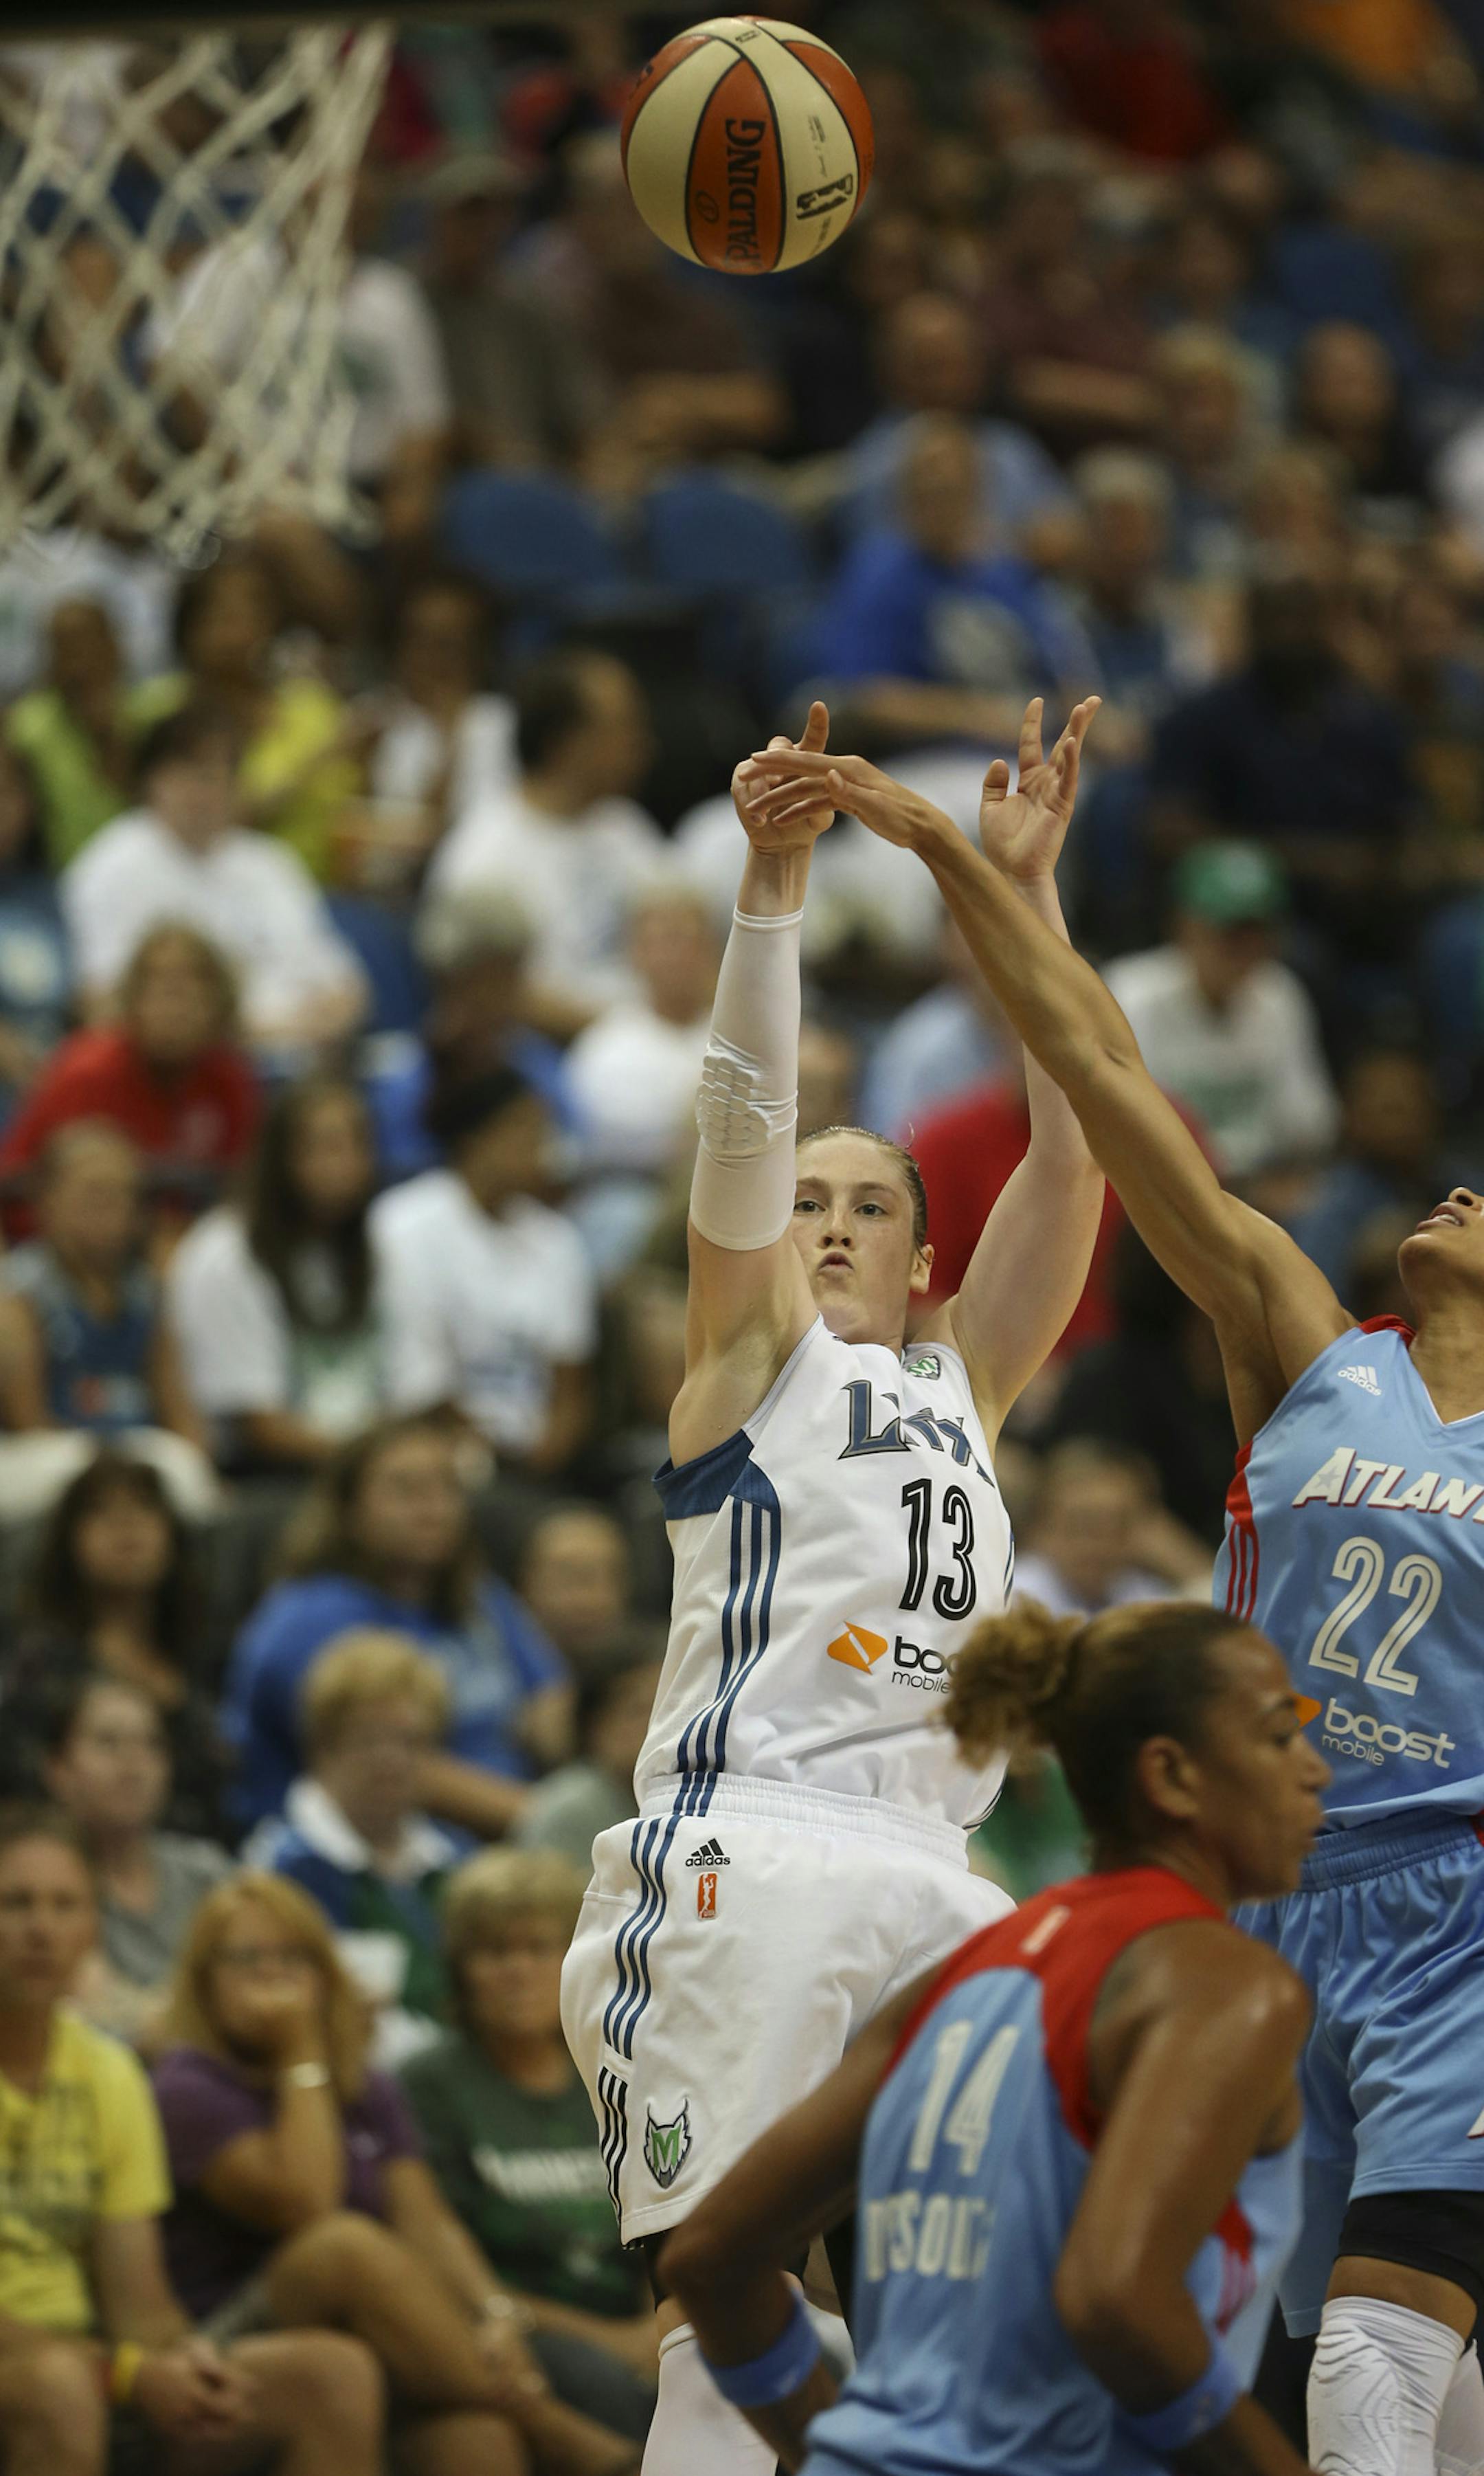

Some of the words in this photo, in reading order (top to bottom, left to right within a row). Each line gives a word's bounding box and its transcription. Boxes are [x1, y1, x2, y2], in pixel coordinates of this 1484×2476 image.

[726, 119, 765, 269] PALDING
[1337, 1370, 1382, 1396] adidas
[1292, 1447, 1484, 1524] ATLAN
[899, 1478, 976, 1620] 13
[1308, 1536, 1442, 1697] 22
[892, 1671, 952, 1694] mobile
[1322, 1733, 1385, 1766] mobile
[1324, 1697, 1456, 1769] boost
[686, 1855, 730, 1866] adidas
[908, 2019, 1021, 2177] 14
